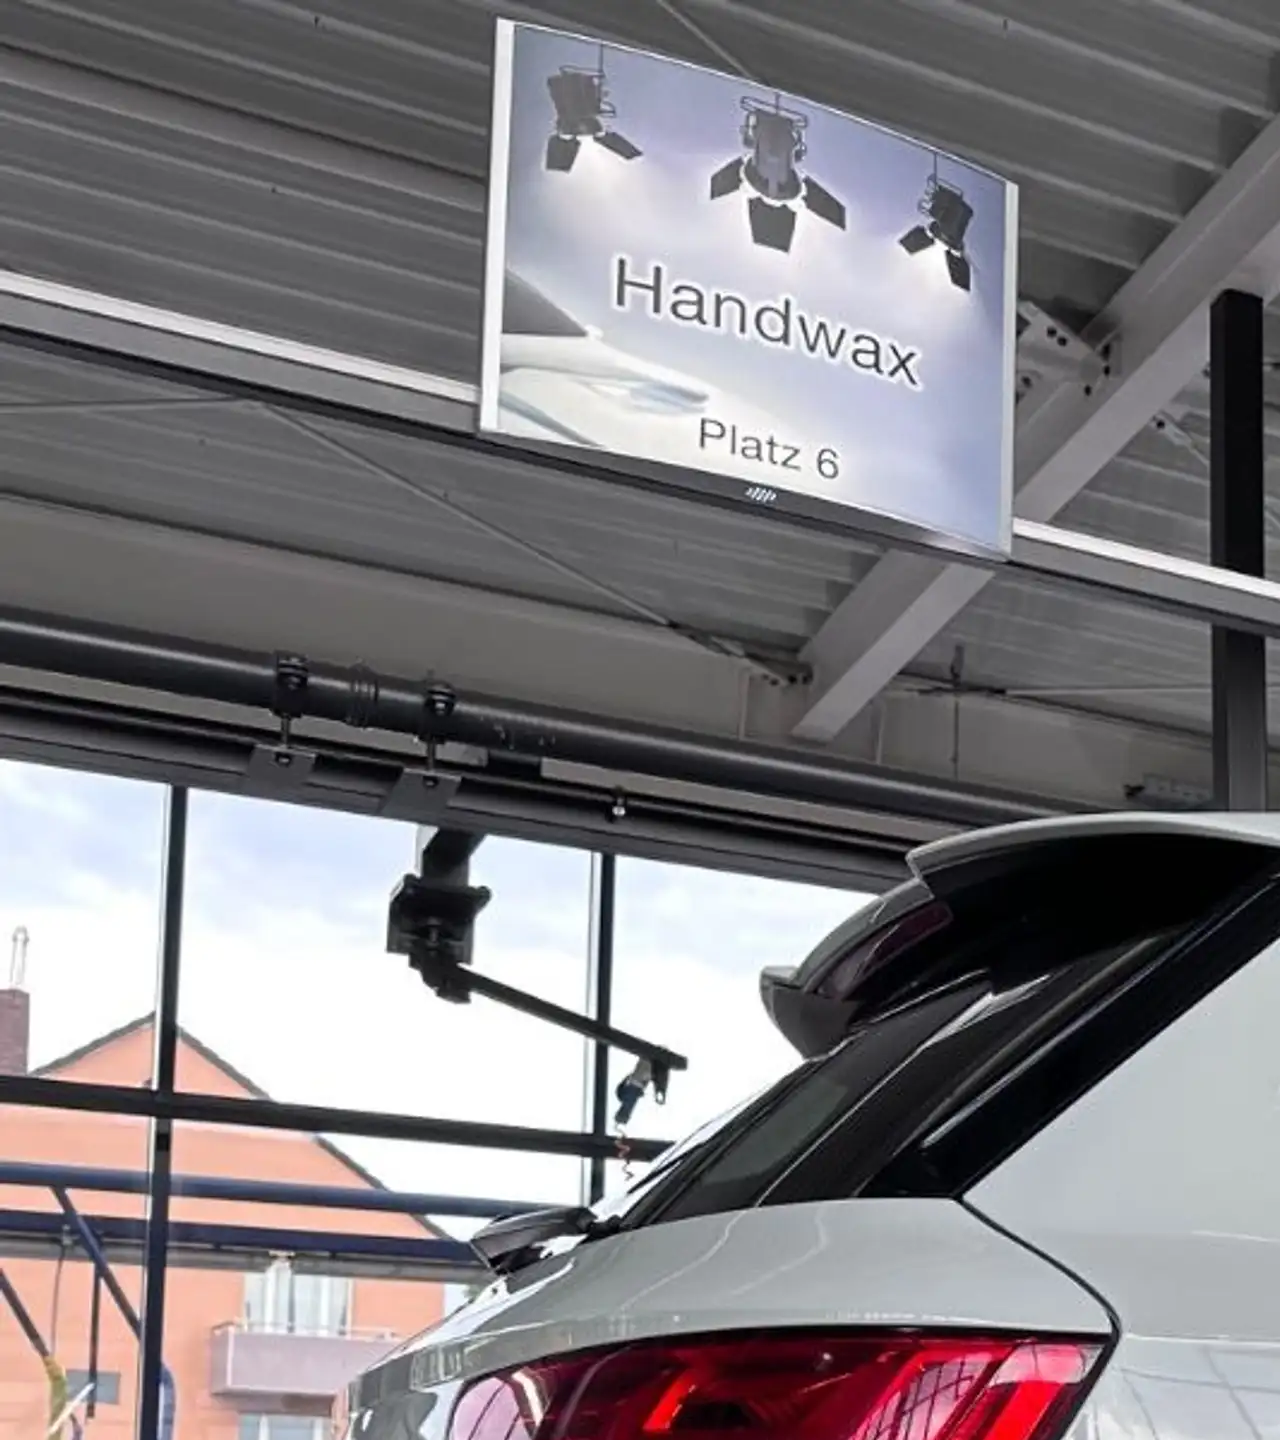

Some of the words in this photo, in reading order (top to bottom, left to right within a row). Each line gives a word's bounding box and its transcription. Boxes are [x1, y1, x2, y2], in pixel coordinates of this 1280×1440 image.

[615, 257, 918, 386] Handwax
[699, 418, 802, 471] Platz
[815, 448, 840, 480] 6
